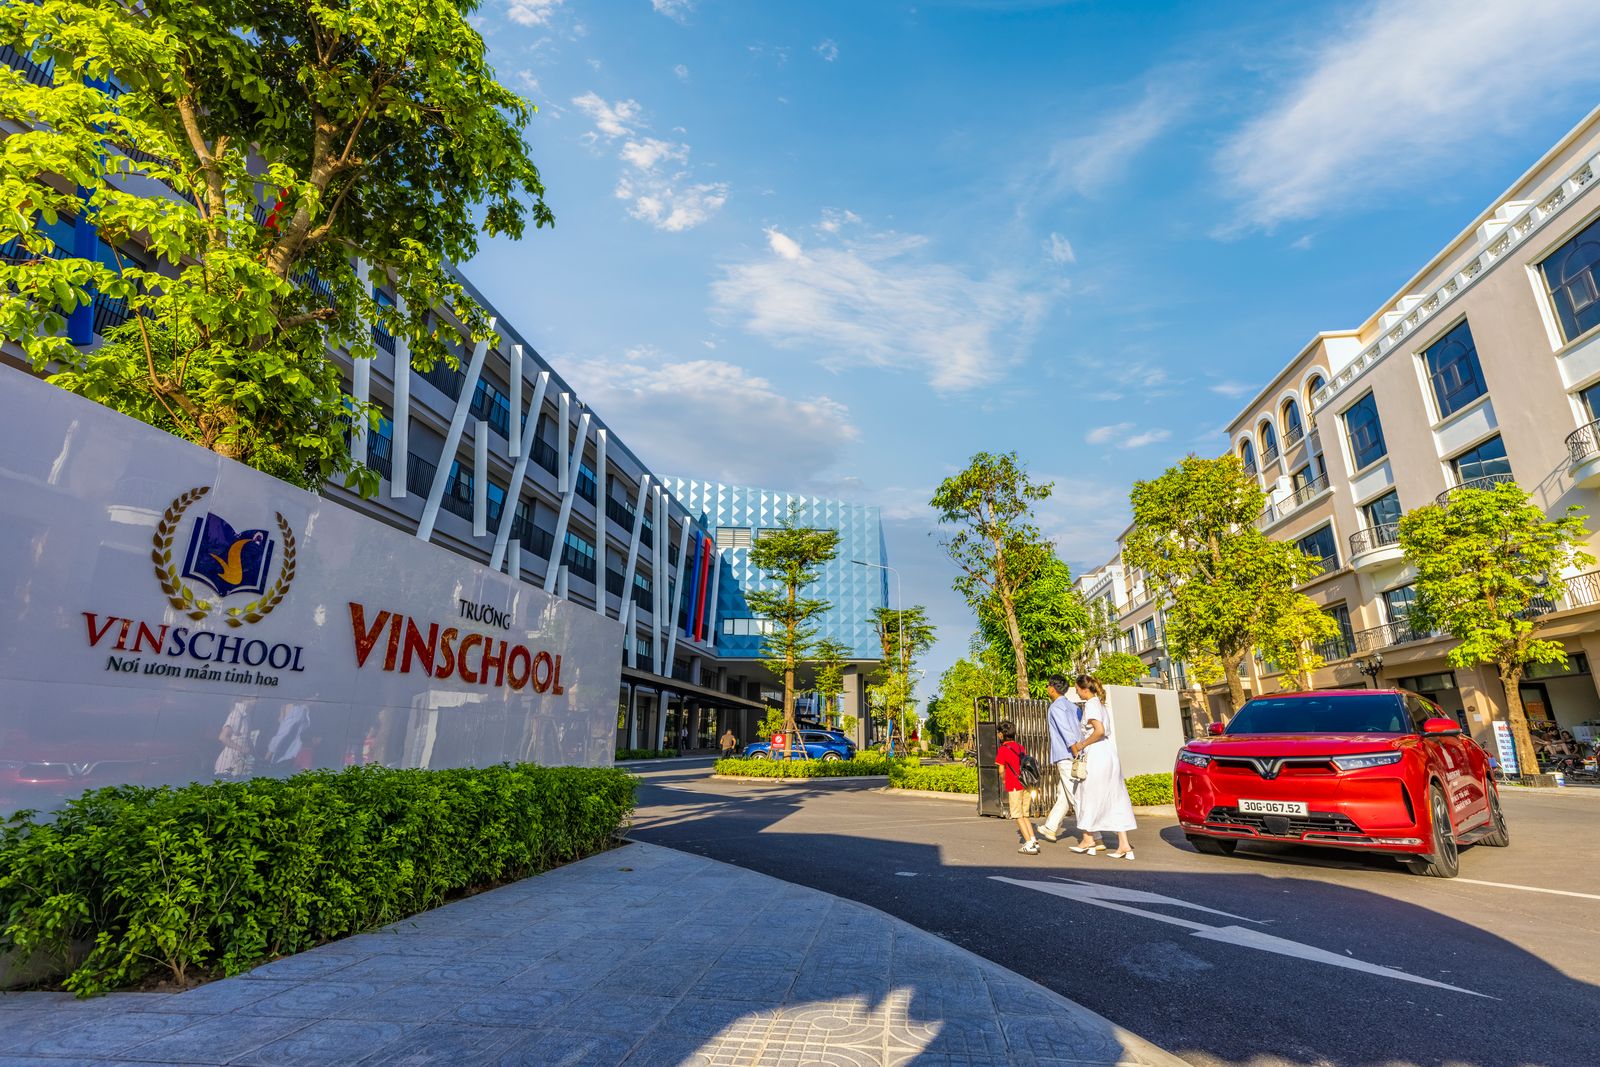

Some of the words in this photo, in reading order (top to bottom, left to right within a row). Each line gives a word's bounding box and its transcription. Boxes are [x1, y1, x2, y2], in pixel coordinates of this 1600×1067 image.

[459, 599, 511, 630] TRƯỜNG
[82, 612, 305, 672] VINSCHOOL
[349, 602, 564, 695] VINSCHOOL
[105, 656, 141, 673] Nơi
[144, 662, 181, 677] ươm
[225, 668, 252, 684] tinh
[255, 671, 279, 686] hoa
[1244, 801, 1301, 814] 30G-067.52
